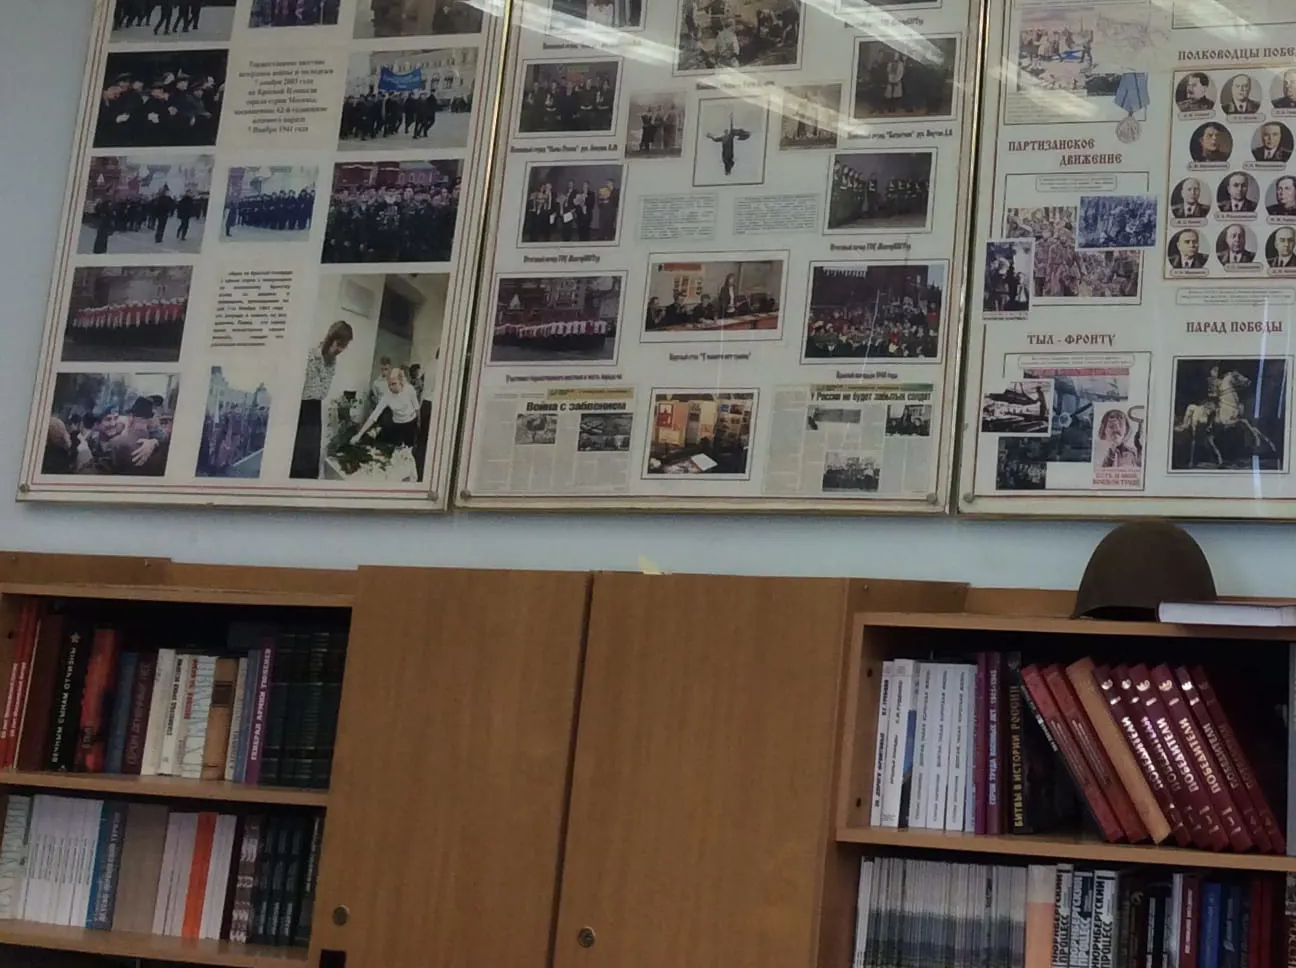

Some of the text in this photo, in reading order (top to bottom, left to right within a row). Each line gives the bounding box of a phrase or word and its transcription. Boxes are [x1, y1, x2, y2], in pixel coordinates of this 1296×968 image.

[1178, 47, 1260, 61] ПОЛКОВОДЦЫ
[1008, 138, 1095, 152] ПАРТИЗАНСКОЕ
[1060, 153, 1122, 166] ДВИЖЕНИЕ
[1027, 334, 1054, 345] ТЫЛ
[1064, 334, 1117, 347] ФРОНТУ
[1186, 320, 1282, 334] ПАРАД ПОБЕДЫ
[526, 402, 558, 411] Война
[568, 402, 627, 411] забвением
[1012, 728, 1022, 772] ИСТОРИИ
[1156, 717, 1199, 792] ПОБЕДИТЕЛИ
[1179, 717, 1221, 794] ПОБЕДИТЕЛИ
[1014, 787, 1024, 828] БИТВЫ
[1059, 914, 1069, 964] ПРОЦЕСС
[1079, 917, 1091, 965] ПРОЦЕСС
[1101, 920, 1113, 968] ПРОЦЕСС
